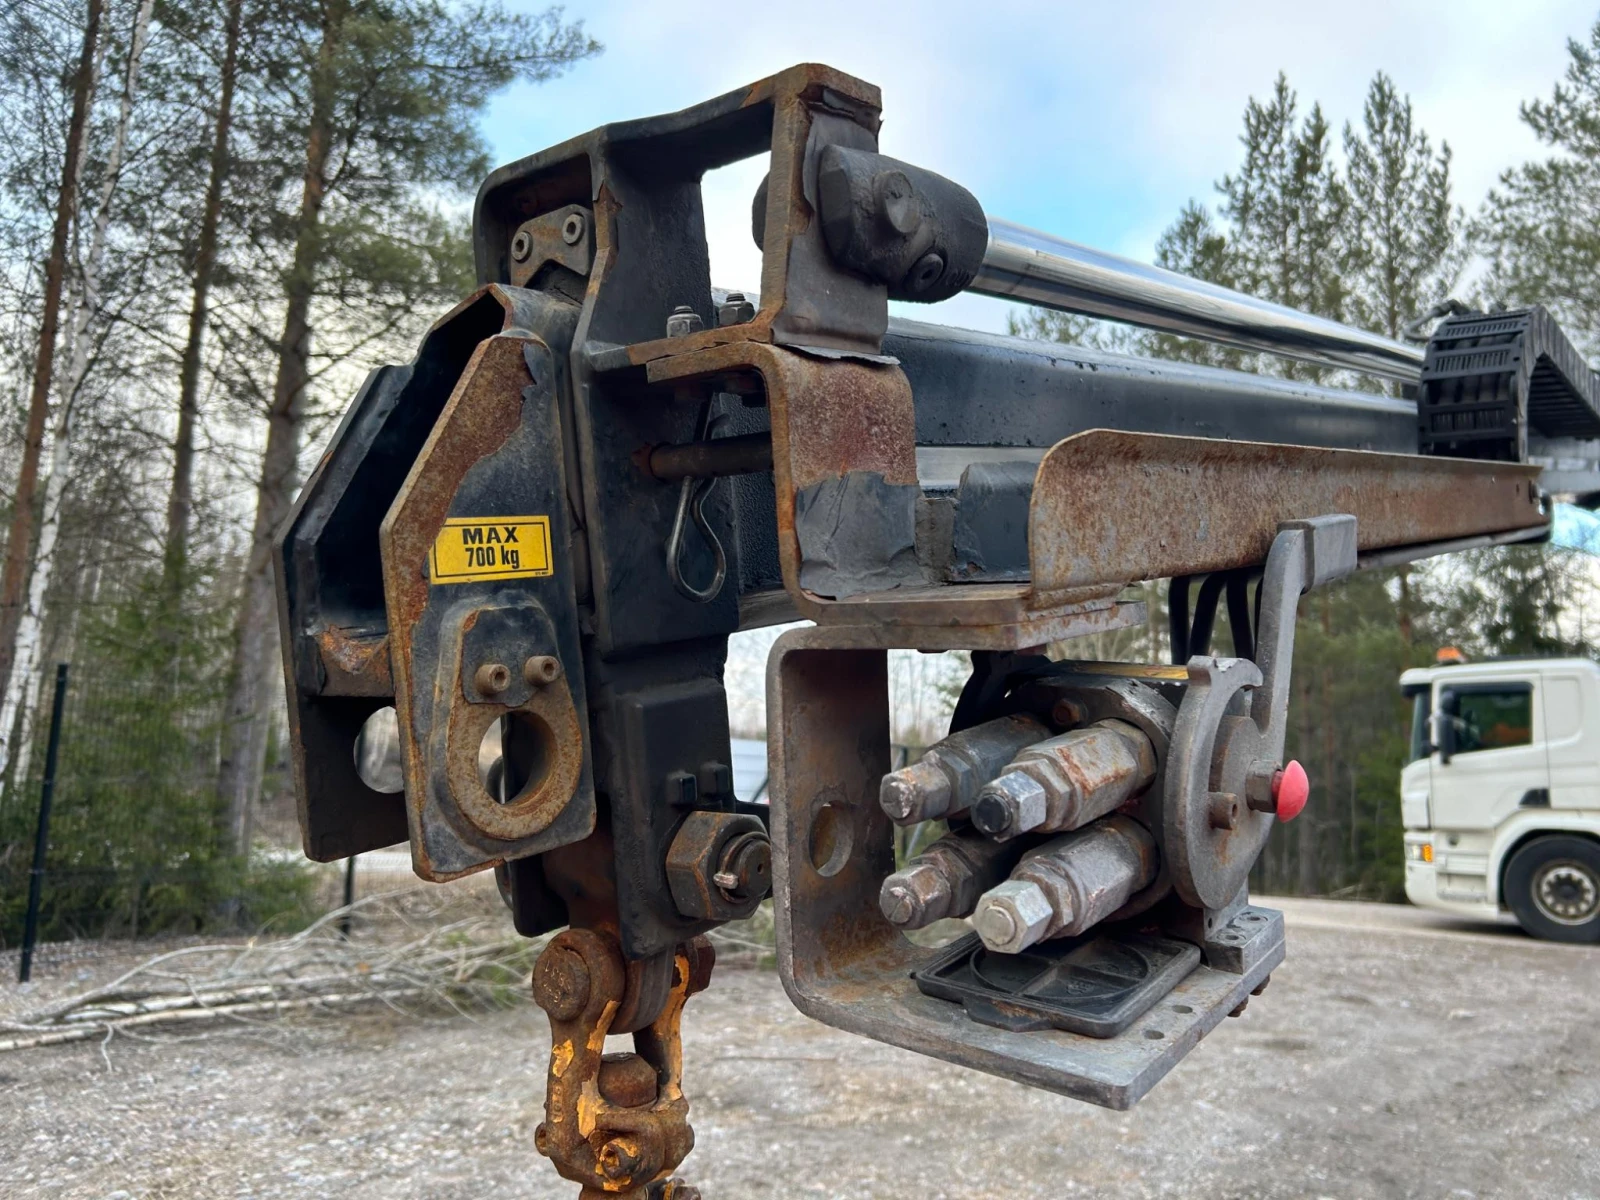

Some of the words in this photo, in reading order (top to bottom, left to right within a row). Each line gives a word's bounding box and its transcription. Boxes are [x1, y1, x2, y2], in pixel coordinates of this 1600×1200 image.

[462, 527, 519, 545] MAX
[465, 546, 496, 567] 700
[501, 545, 520, 569] kg
